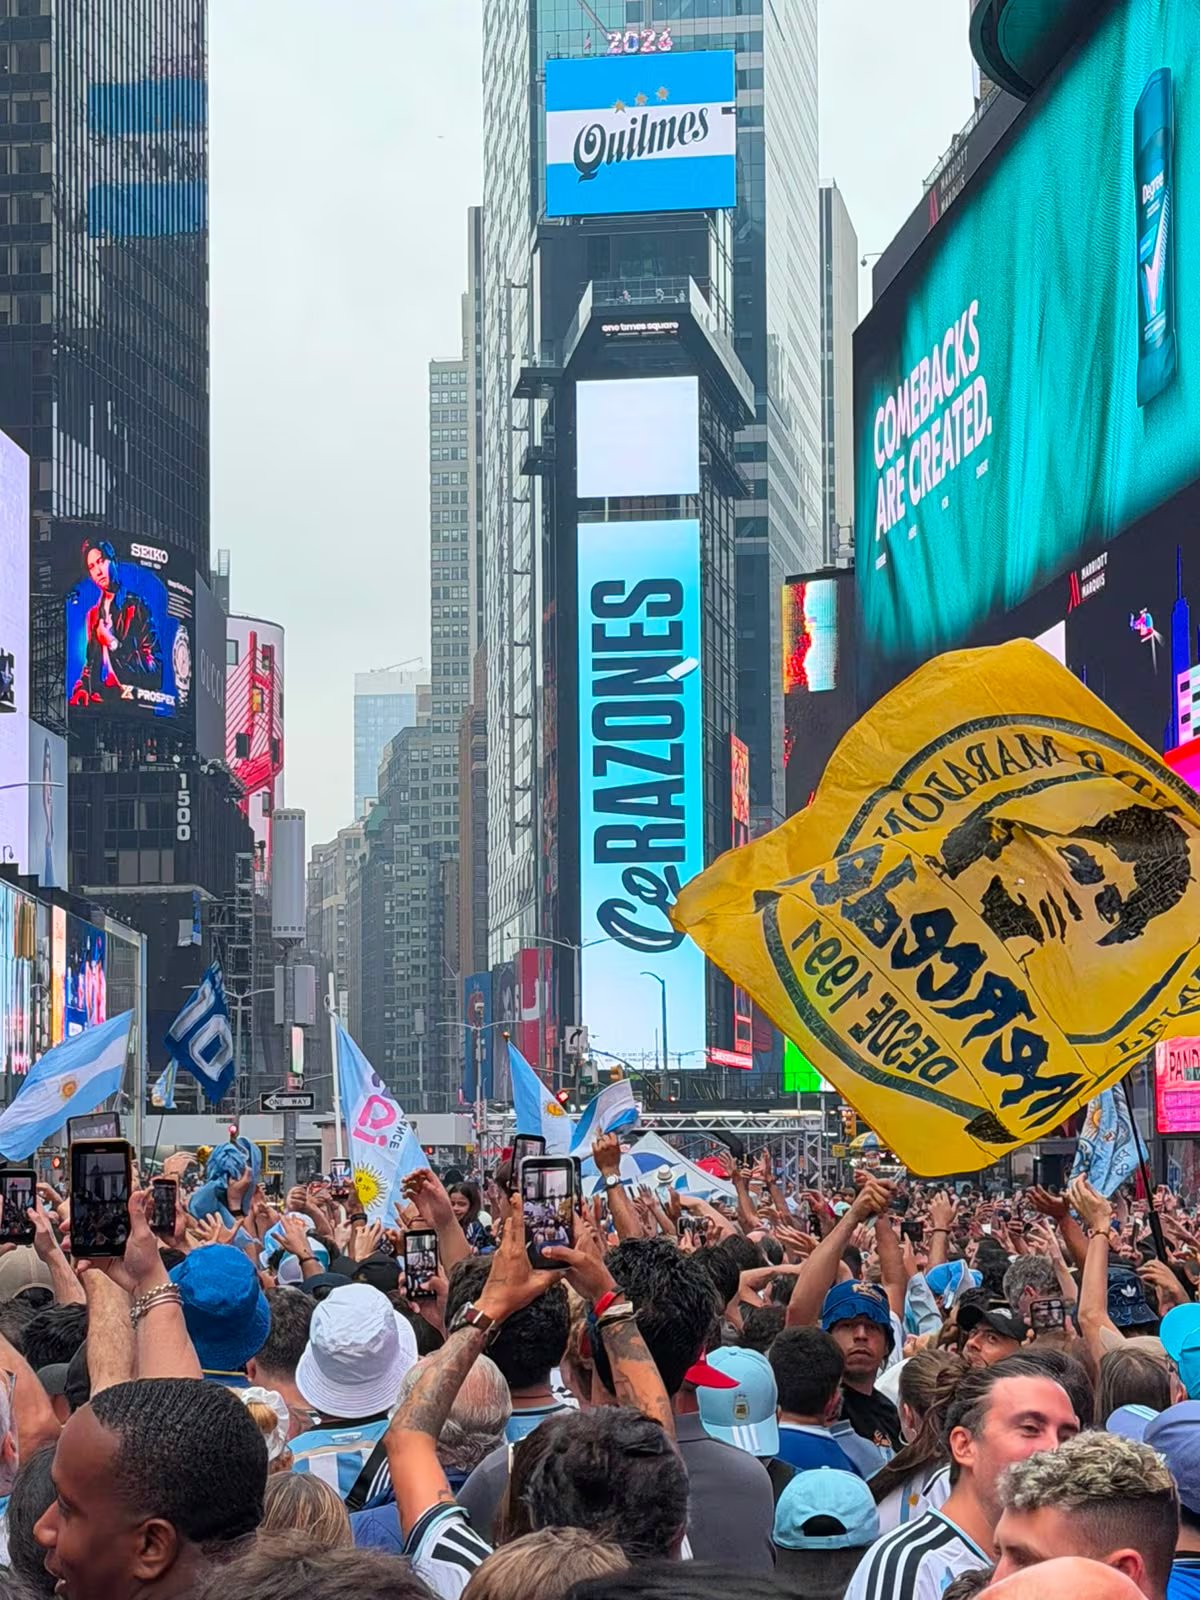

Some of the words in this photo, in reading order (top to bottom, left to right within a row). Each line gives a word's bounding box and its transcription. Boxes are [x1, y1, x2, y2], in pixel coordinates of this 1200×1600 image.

[606, 27, 674, 54] 2026
[573, 106, 709, 184] Quilmes
[601, 324, 620, 332] one
[620, 322, 646, 331] times
[646, 321, 679, 331] square
[873, 299, 980, 469] COMEBACKS
[874, 455, 906, 542] ARE
[908, 375, 992, 506] CREATED.
[130, 543, 169, 564] SEIKO
[1081, 551, 1108, 581] MARRIOTT
[1081, 572, 1105, 599] MARQUIS
[137, 688, 176, 707] PROSPEX
[177, 773, 191, 841] 1500
[168, 977, 234, 1082] 10
[1169, 1048, 1200, 1082] PAND
[269, 1098, 284, 1106] ONE
